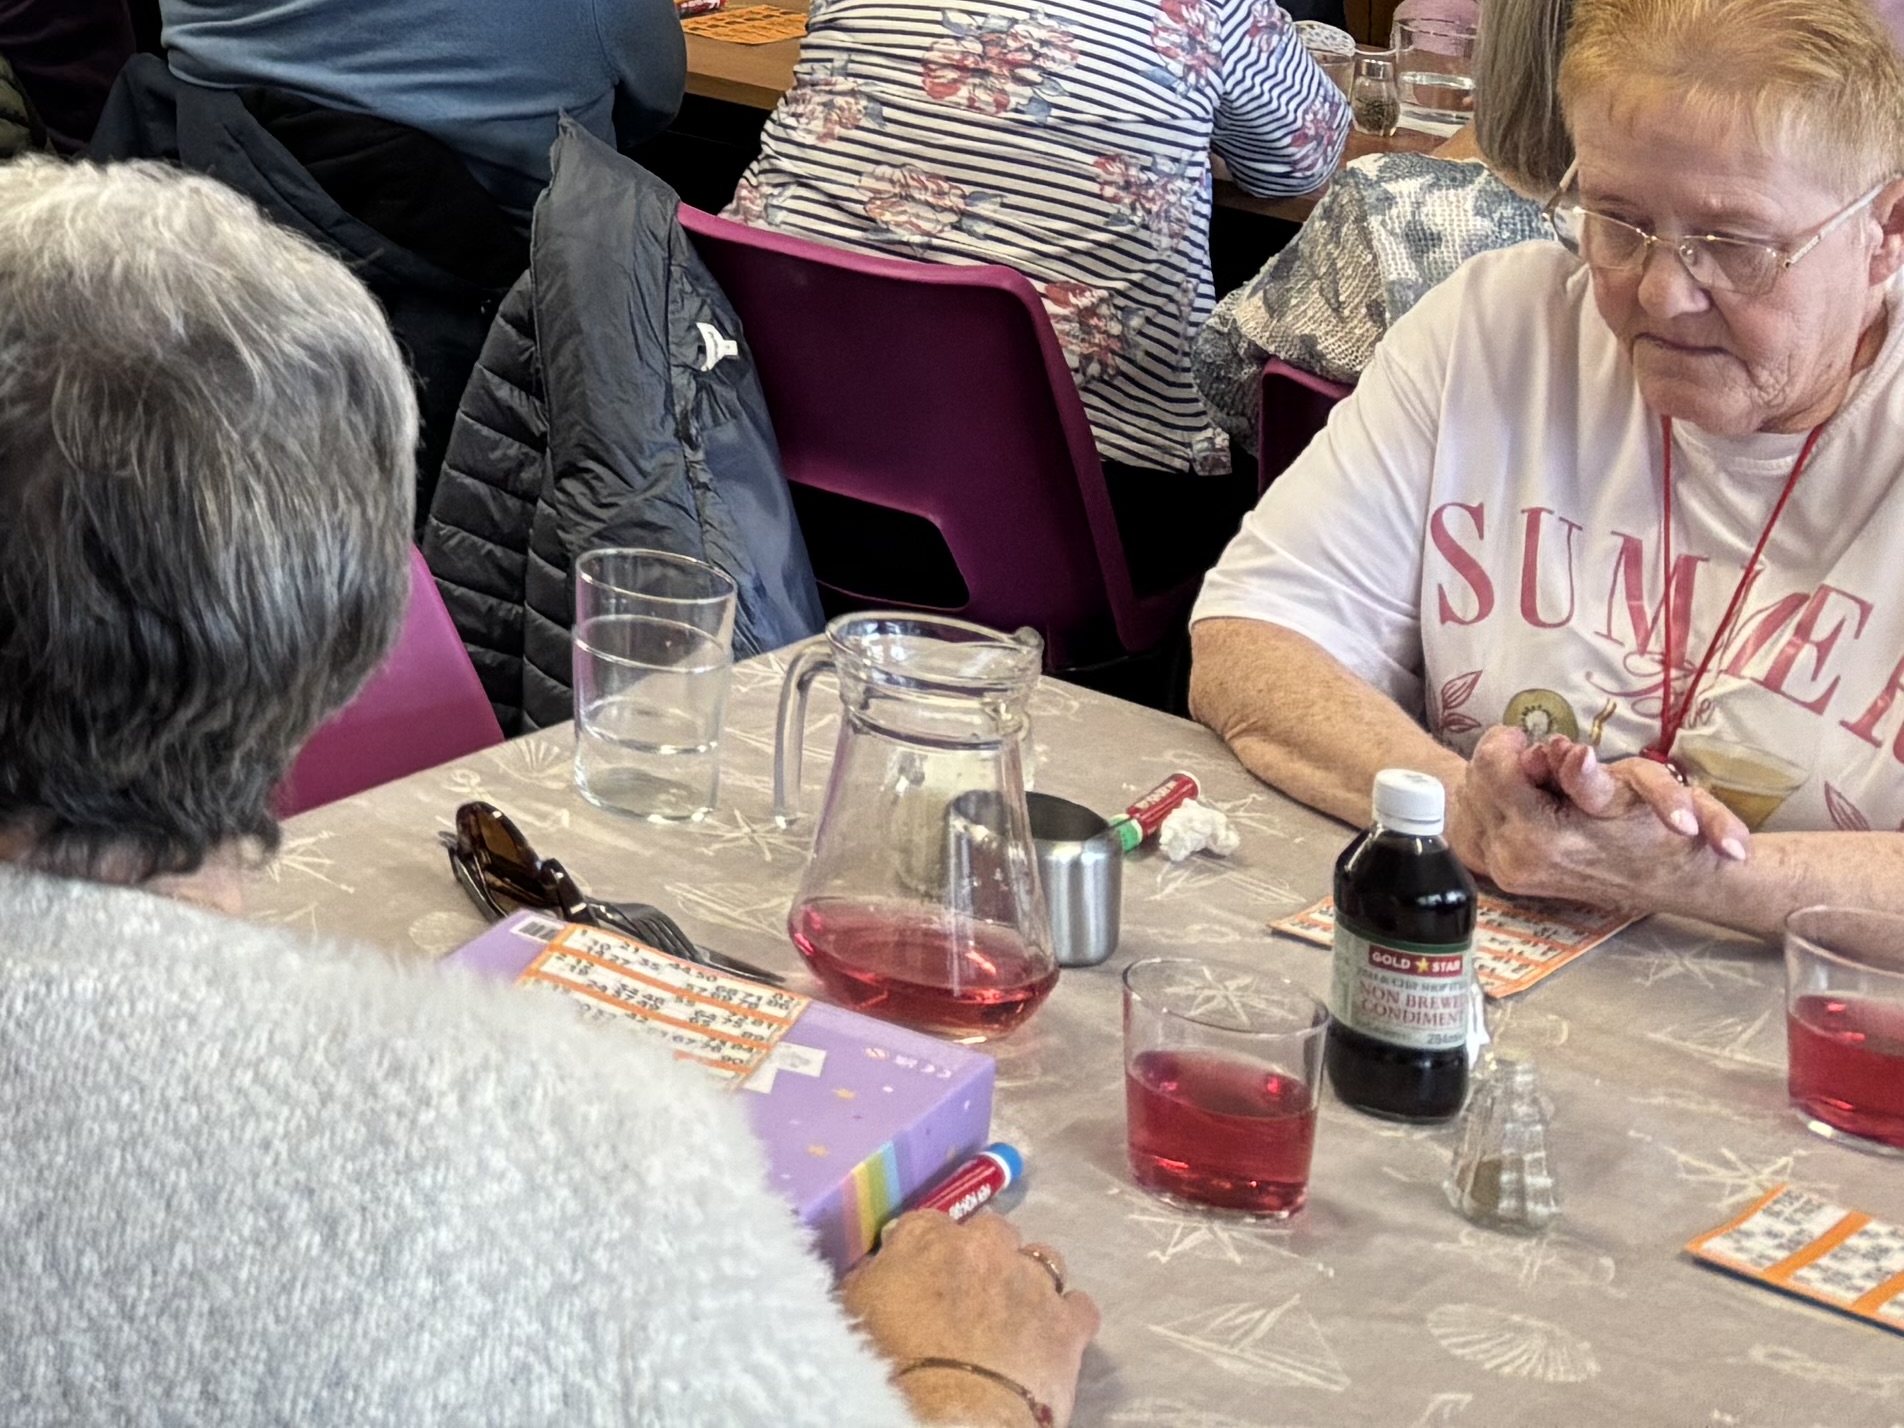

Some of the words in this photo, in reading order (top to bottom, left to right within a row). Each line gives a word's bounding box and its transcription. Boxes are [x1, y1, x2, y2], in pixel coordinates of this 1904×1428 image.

[1371, 951, 1411, 970] GOLD
[1432, 959, 1461, 973] STAR
[1359, 979, 1400, 1004] NON
[1406, 993, 1470, 1012] BREWE
[1361, 998, 1465, 1026] CONDIMENT
